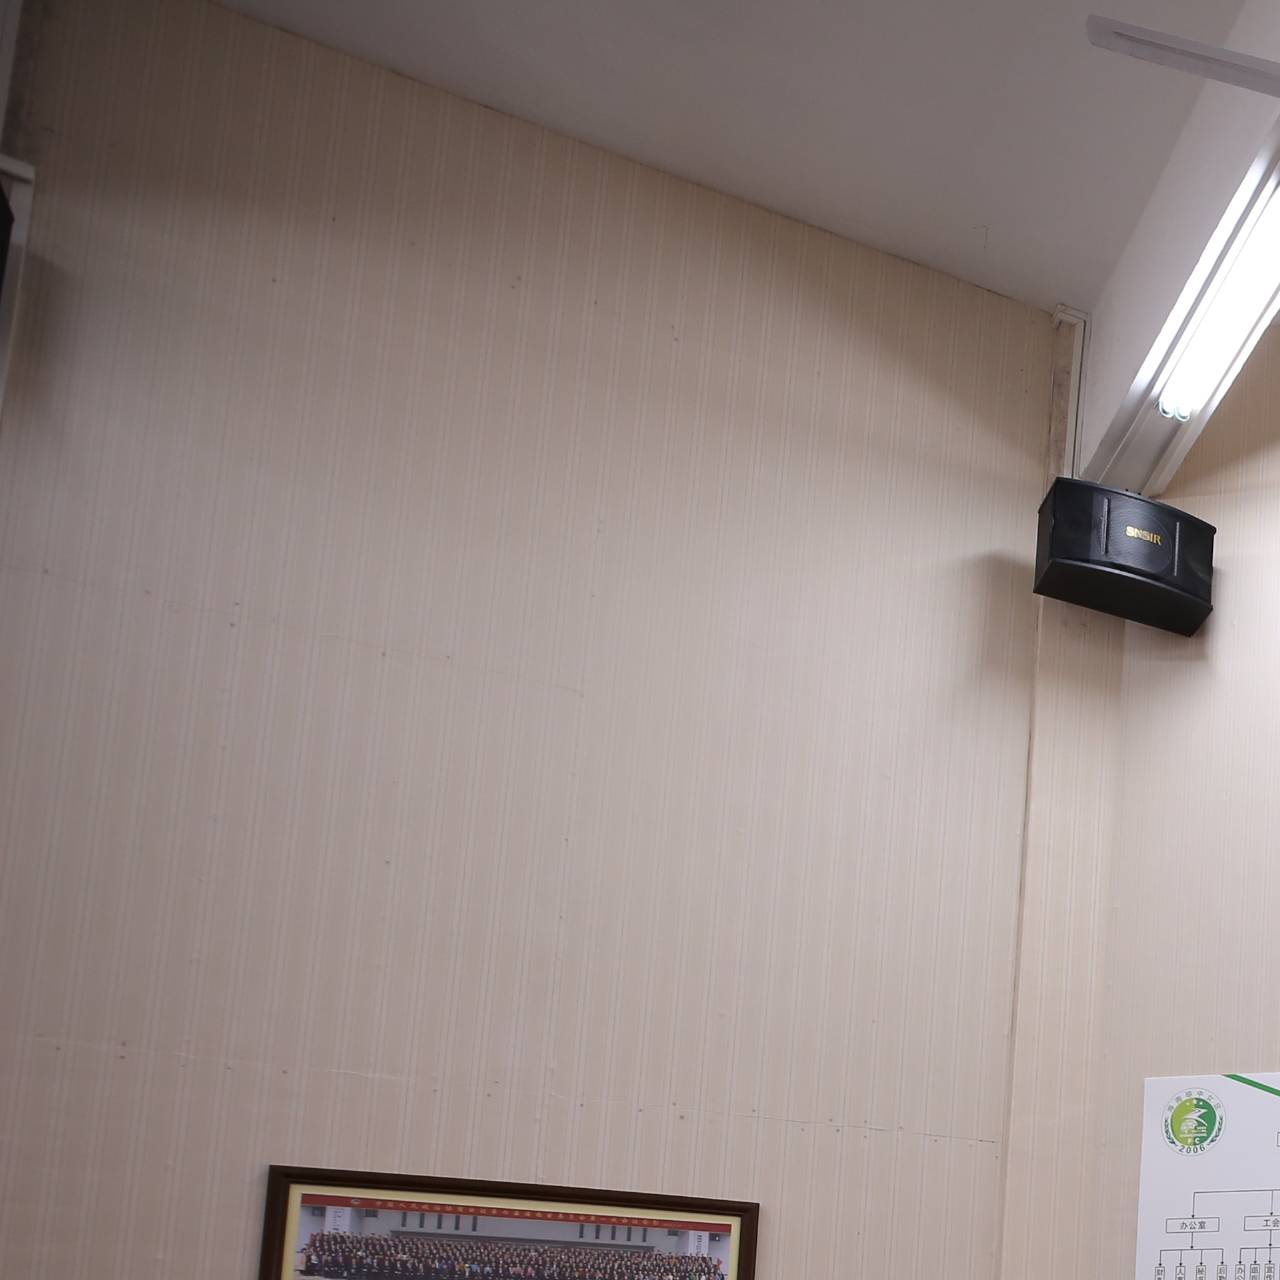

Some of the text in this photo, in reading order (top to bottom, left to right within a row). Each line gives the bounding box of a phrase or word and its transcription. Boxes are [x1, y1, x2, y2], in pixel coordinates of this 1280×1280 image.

[1178, 1144, 1206, 1154] 2006
[1180, 1220, 1206, 1230] 办公室
[1263, 1218, 1280, 1228] 工会
